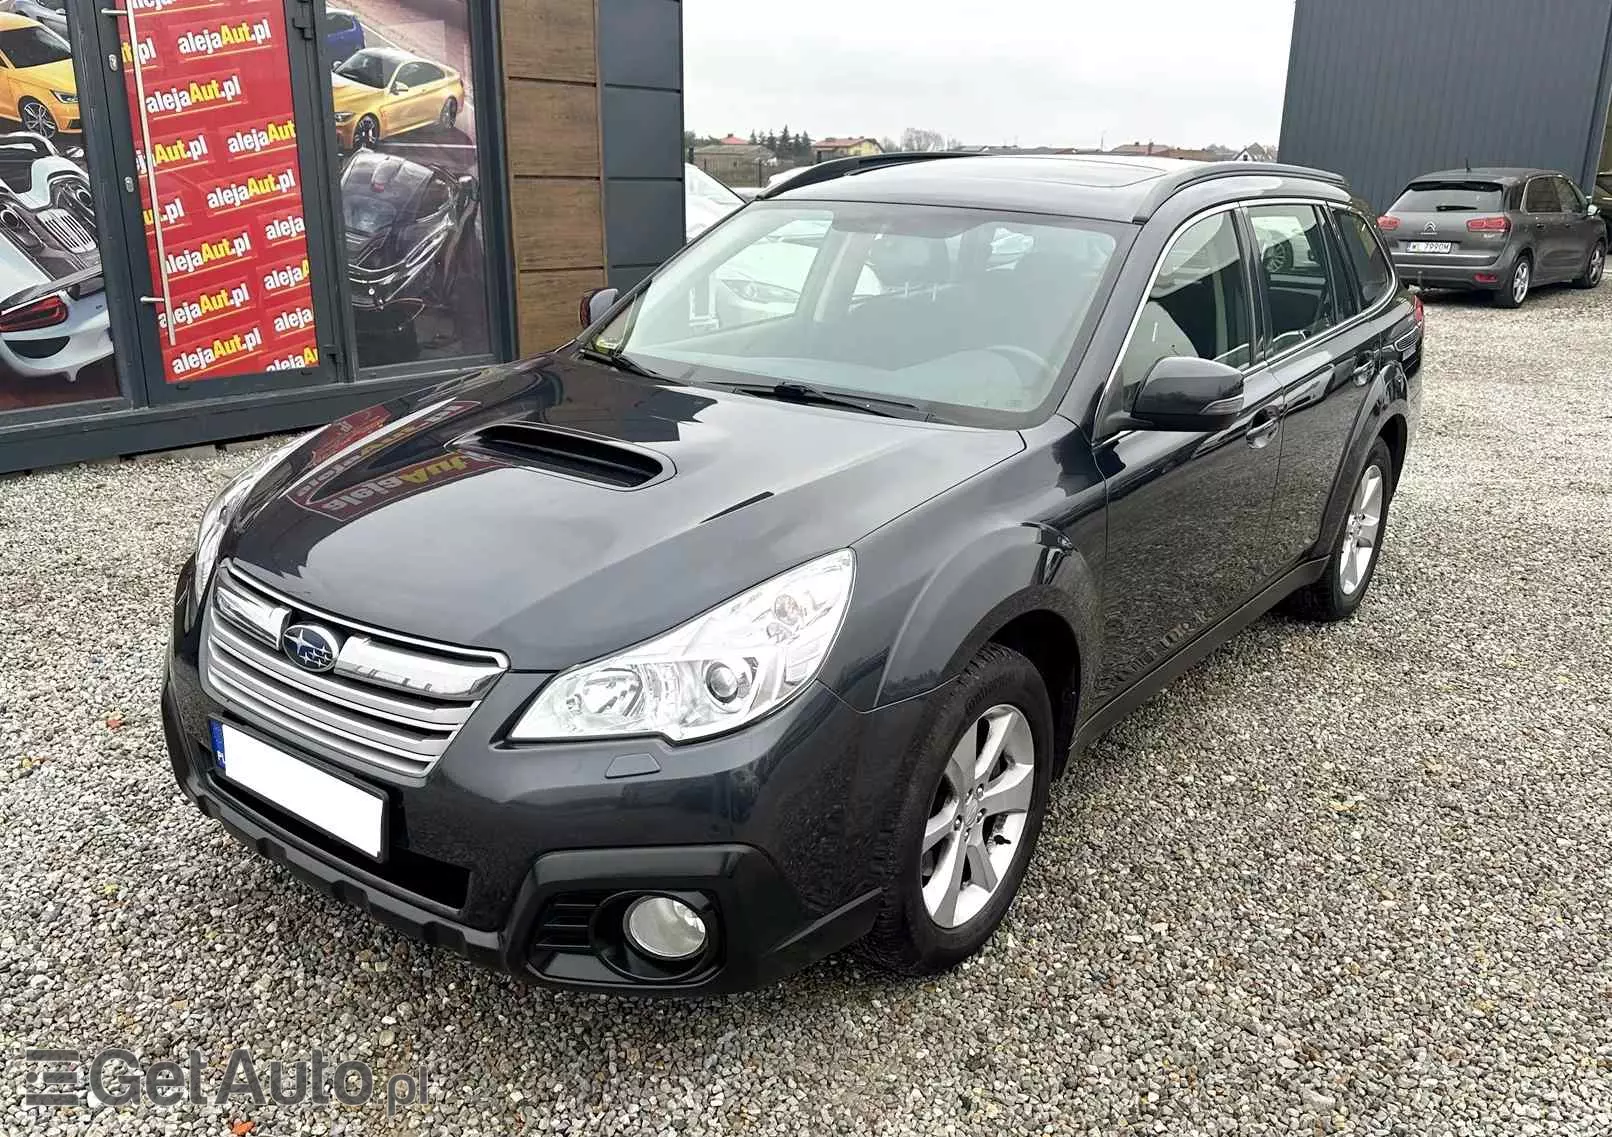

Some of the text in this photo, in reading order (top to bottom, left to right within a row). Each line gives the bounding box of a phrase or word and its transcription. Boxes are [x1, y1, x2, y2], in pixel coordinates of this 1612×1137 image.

[121, 38, 157, 65] tpl
[177, 19, 272, 55] alejaAut.pl
[145, 75, 241, 114] alejaAut.pl
[227, 120, 296, 153] alejaAut
[207, 168, 296, 208] alejaAut.pl
[143, 198, 186, 225] u.pl
[265, 215, 306, 240] aleja
[158, 282, 250, 329] aejaAut.pl
[273, 307, 313, 332] aleja
[171, 326, 263, 375] alejaAut.pl
